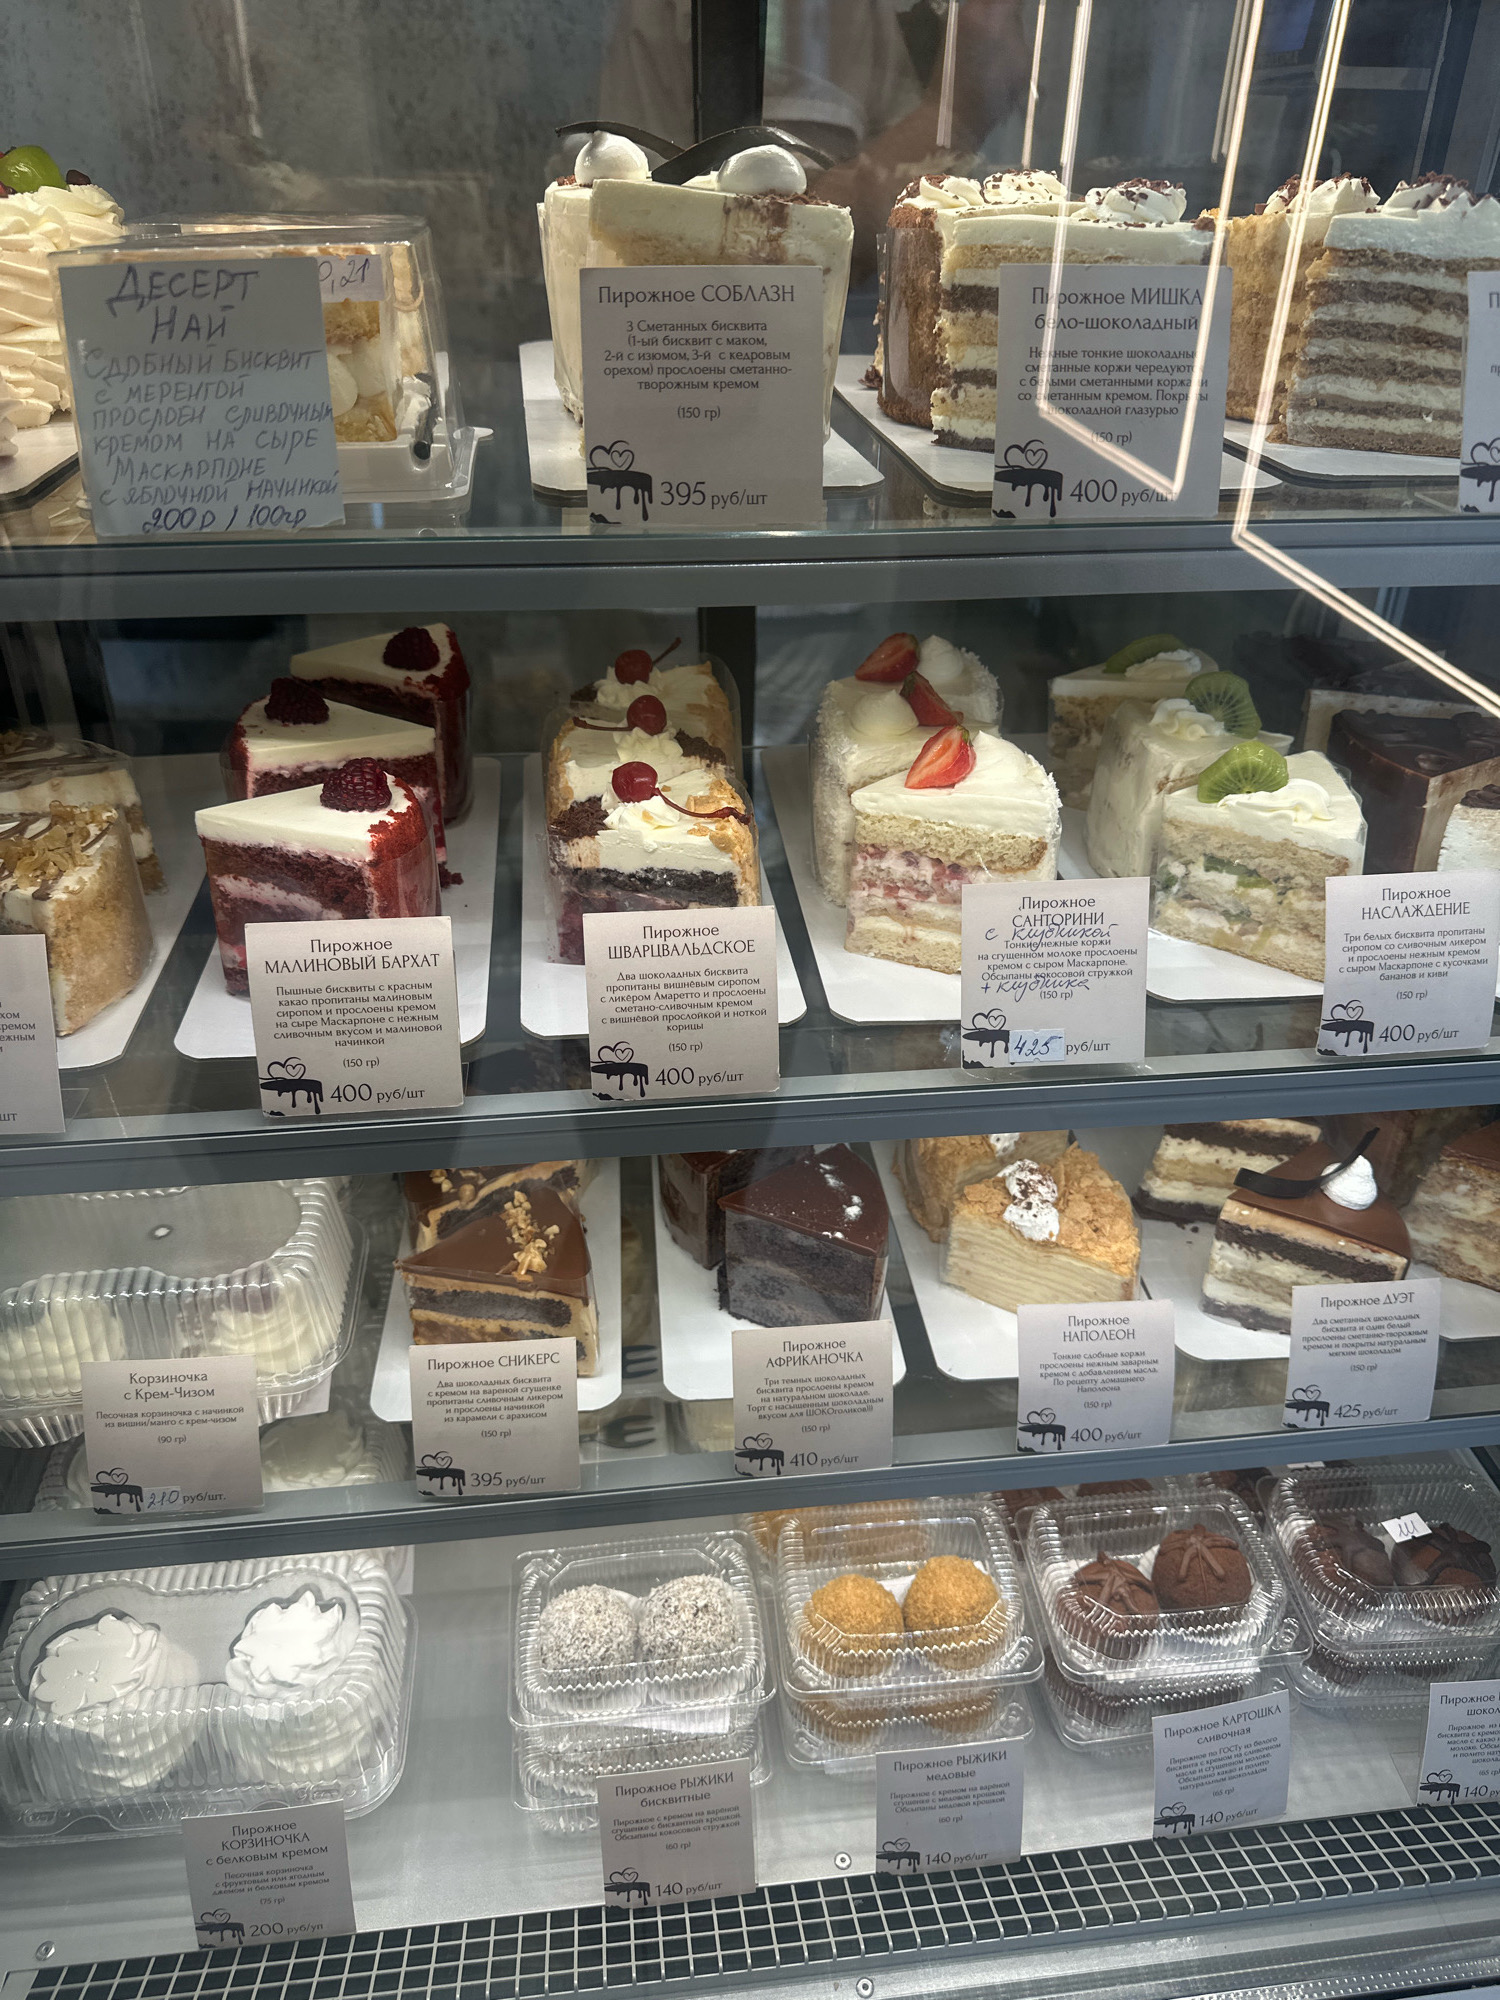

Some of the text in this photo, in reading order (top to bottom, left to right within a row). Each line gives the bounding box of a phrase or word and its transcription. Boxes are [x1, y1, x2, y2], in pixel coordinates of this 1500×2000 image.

[107, 265, 258, 318] ДЕСЕРТ
[598, 285, 794, 307] Пирожное СОБЛАЗН
[1131, 288, 1203, 305] МИШКА
[151, 306, 235, 344] НАЙ
[626, 320, 767, 332] 3 Сметанных бисквита
[1035, 315, 1198, 331] бело-шоколадный
[662, 335, 712, 346] бисквит
[726, 337, 767, 347] маком,
[604, 350, 790, 366] 2-й с изюмом, 3-й с кедровым
[604, 365, 792, 378] орехом) прослоены сметанно-
[638, 380, 759, 392] творожным кремом
[678, 406, 720, 419] (150 гр)
[1116, 432, 1132, 444] гр)
[660, 482, 768, 508] 395 руб/шт
[1070, 479, 1117, 503] 400
[1382, 888, 1450, 903] Пирожное
[1022, 897, 1095, 912] Пирожное
[1362, 902, 1470, 920] НАСЛАЖДЕНИЕ
[1012, 912, 1104, 927] САНТОРИНИ
[643, 926, 719, 941] Пирожное
[311, 939, 392, 955] Пирожное
[608, 940, 755, 959] ШВАРЦВАЛЬДСКОЕ
[265, 954, 439, 974] МАЛИНОВЫЙ БАРХАТ
[276, 987, 322, 996] Пышные
[325, 984, 375, 994] бисквиты
[388, 982, 433, 991] красным
[1040, 990, 1073, 1000] (150 гр)
[1396, 990, 1427, 1000] (150 гр)
[279, 993, 433, 1007] какао пропитаны малиновым
[276, 1009, 322, 1019] сиропом
[336, 1005, 393, 1016] прослоены
[398, 1004, 436, 1013] кремом
[292, 1020, 317, 1029] сыре
[321, 1016, 385, 1027] Маскарпоне
[397, 1014, 439, 1022] нежным
[274, 1030, 332, 1039] сливочным
[336, 1028, 372, 1038] вкусом
[386, 1024, 442, 1034] малиновой
[1379, 1025, 1459, 1042] 400 руб/шт
[335, 1038, 384, 1047] начинкой
[668, 1042, 703, 1052] (150 гр)
[1014, 1035, 1110, 1056] 425 руб/шт
[343, 1057, 380, 1068] (150 гр)
[656, 1067, 743, 1086] 400 руб/шт
[331, 1083, 425, 1103] 400 руб/шт
[1321, 1292, 1414, 1309] Пирожное ДУЭТ
[1068, 1316, 1130, 1329] Пирожное
[1063, 1329, 1135, 1342] НАПОЛЕОН
[783, 1340, 846, 1354] Пирожное
[428, 1352, 560, 1372] Пирожное СНИКЕРС
[766, 1352, 863, 1368] АФРИКАНОЧКА
[130, 1372, 208, 1386] Корзиночка
[124, 1387, 215, 1402] с Крем-Чизом
[1334, 1404, 1399, 1419] 425 руб/шт
[175, 1435, 186, 1444] гр)
[481, 1429, 511, 1438] (150 гр)
[1071, 1428, 1142, 1443] 400 руб/шт
[790, 1452, 859, 1467] 410 руб/шт
[471, 1472, 545, 1488] 395 руб/шт
[183, 1492, 226, 1504] руб/шт.
[1440, 1695, 1495, 1706] Пирожное
[1164, 1705, 1281, 1738] Пирожное КАРТОШКА
[1197, 1727, 1251, 1744] сливочная
[894, 1750, 1007, 1772] Пирожное РЫЖИКИ
[926, 1770, 976, 1781] медовые
[616, 1772, 734, 1797] Пирожное РЫЖИКИ
[1464, 1785, 1488, 1798] 140
[640, 1792, 711, 1807] бисквитные
[1200, 1808, 1258, 1826] 140 руб/шт
[232, 1822, 297, 1837] Пирожное
[222, 1833, 310, 1851] КОРЗИНОЧКА
[217, 1851, 278, 1865] белковым
[282, 1846, 328, 1860] кремом
[926, 1852, 989, 1865] 140 руб/шт
[656, 1883, 722, 1896] 140 руб/шт
[251, 1923, 283, 1937] 200
